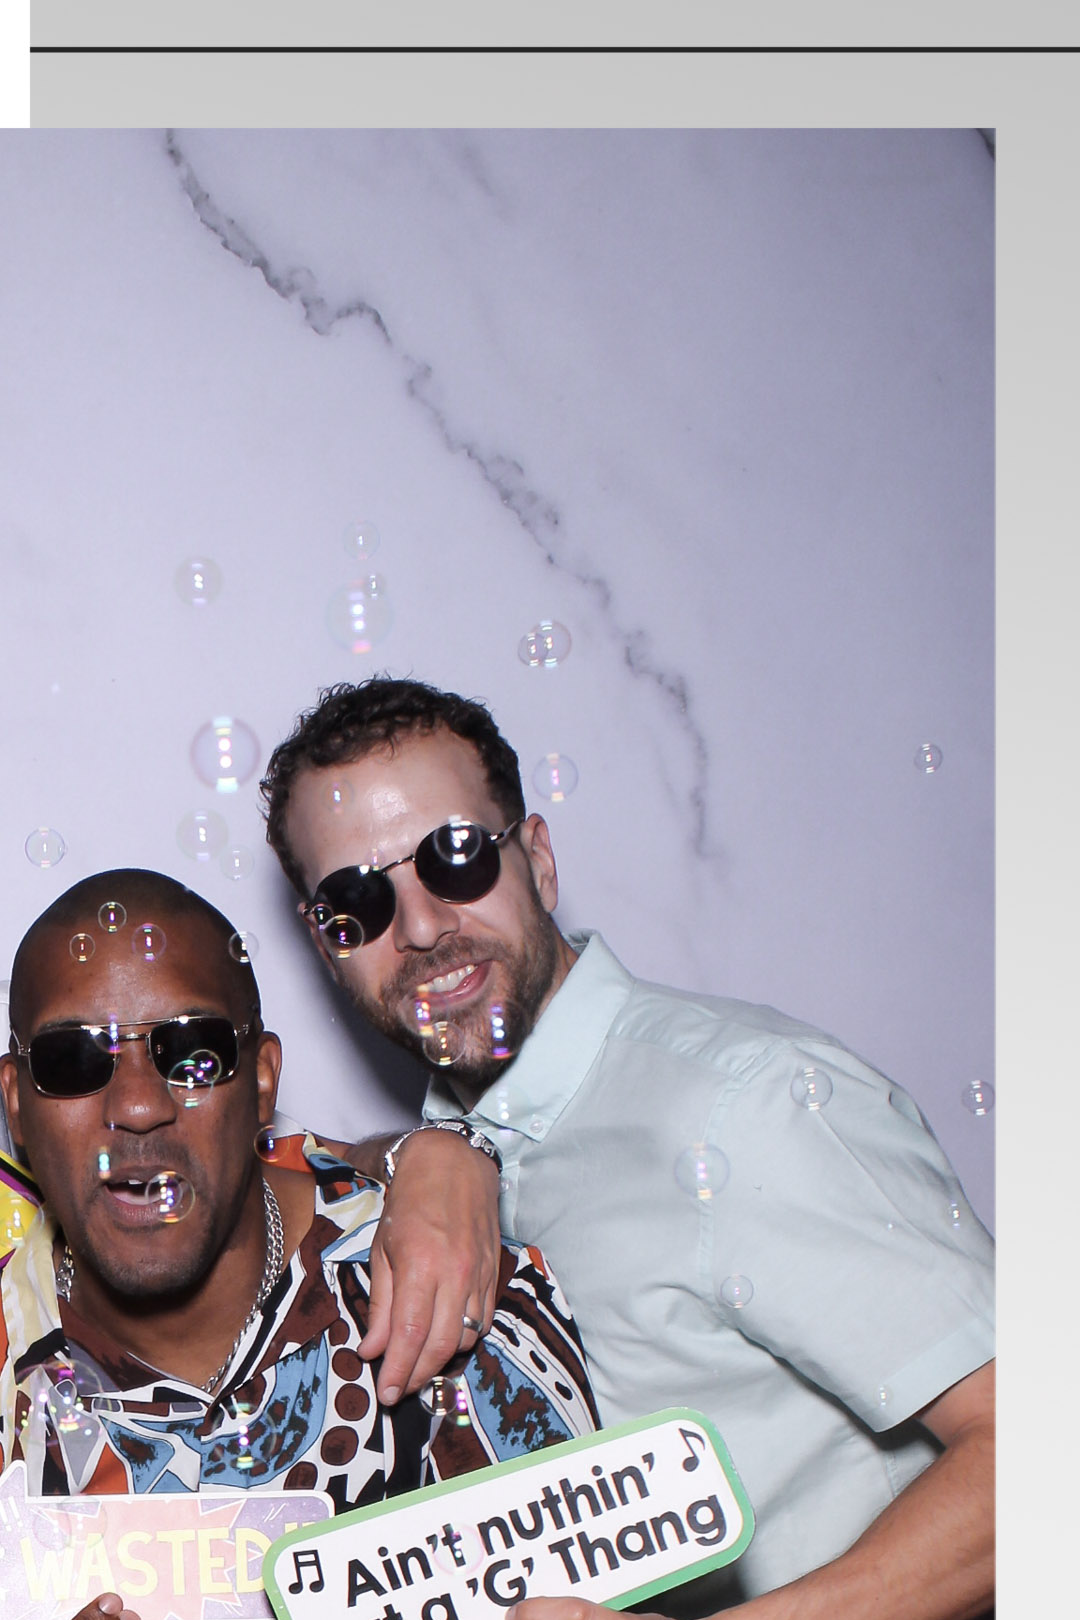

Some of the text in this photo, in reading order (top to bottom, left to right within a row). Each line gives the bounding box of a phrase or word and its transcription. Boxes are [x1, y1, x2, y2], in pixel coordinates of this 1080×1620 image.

[20, 1522, 316, 1602] WASTED
[347, 1452, 655, 1608] Ain't nuthin'
[548, 1495, 727, 1584] Thang
